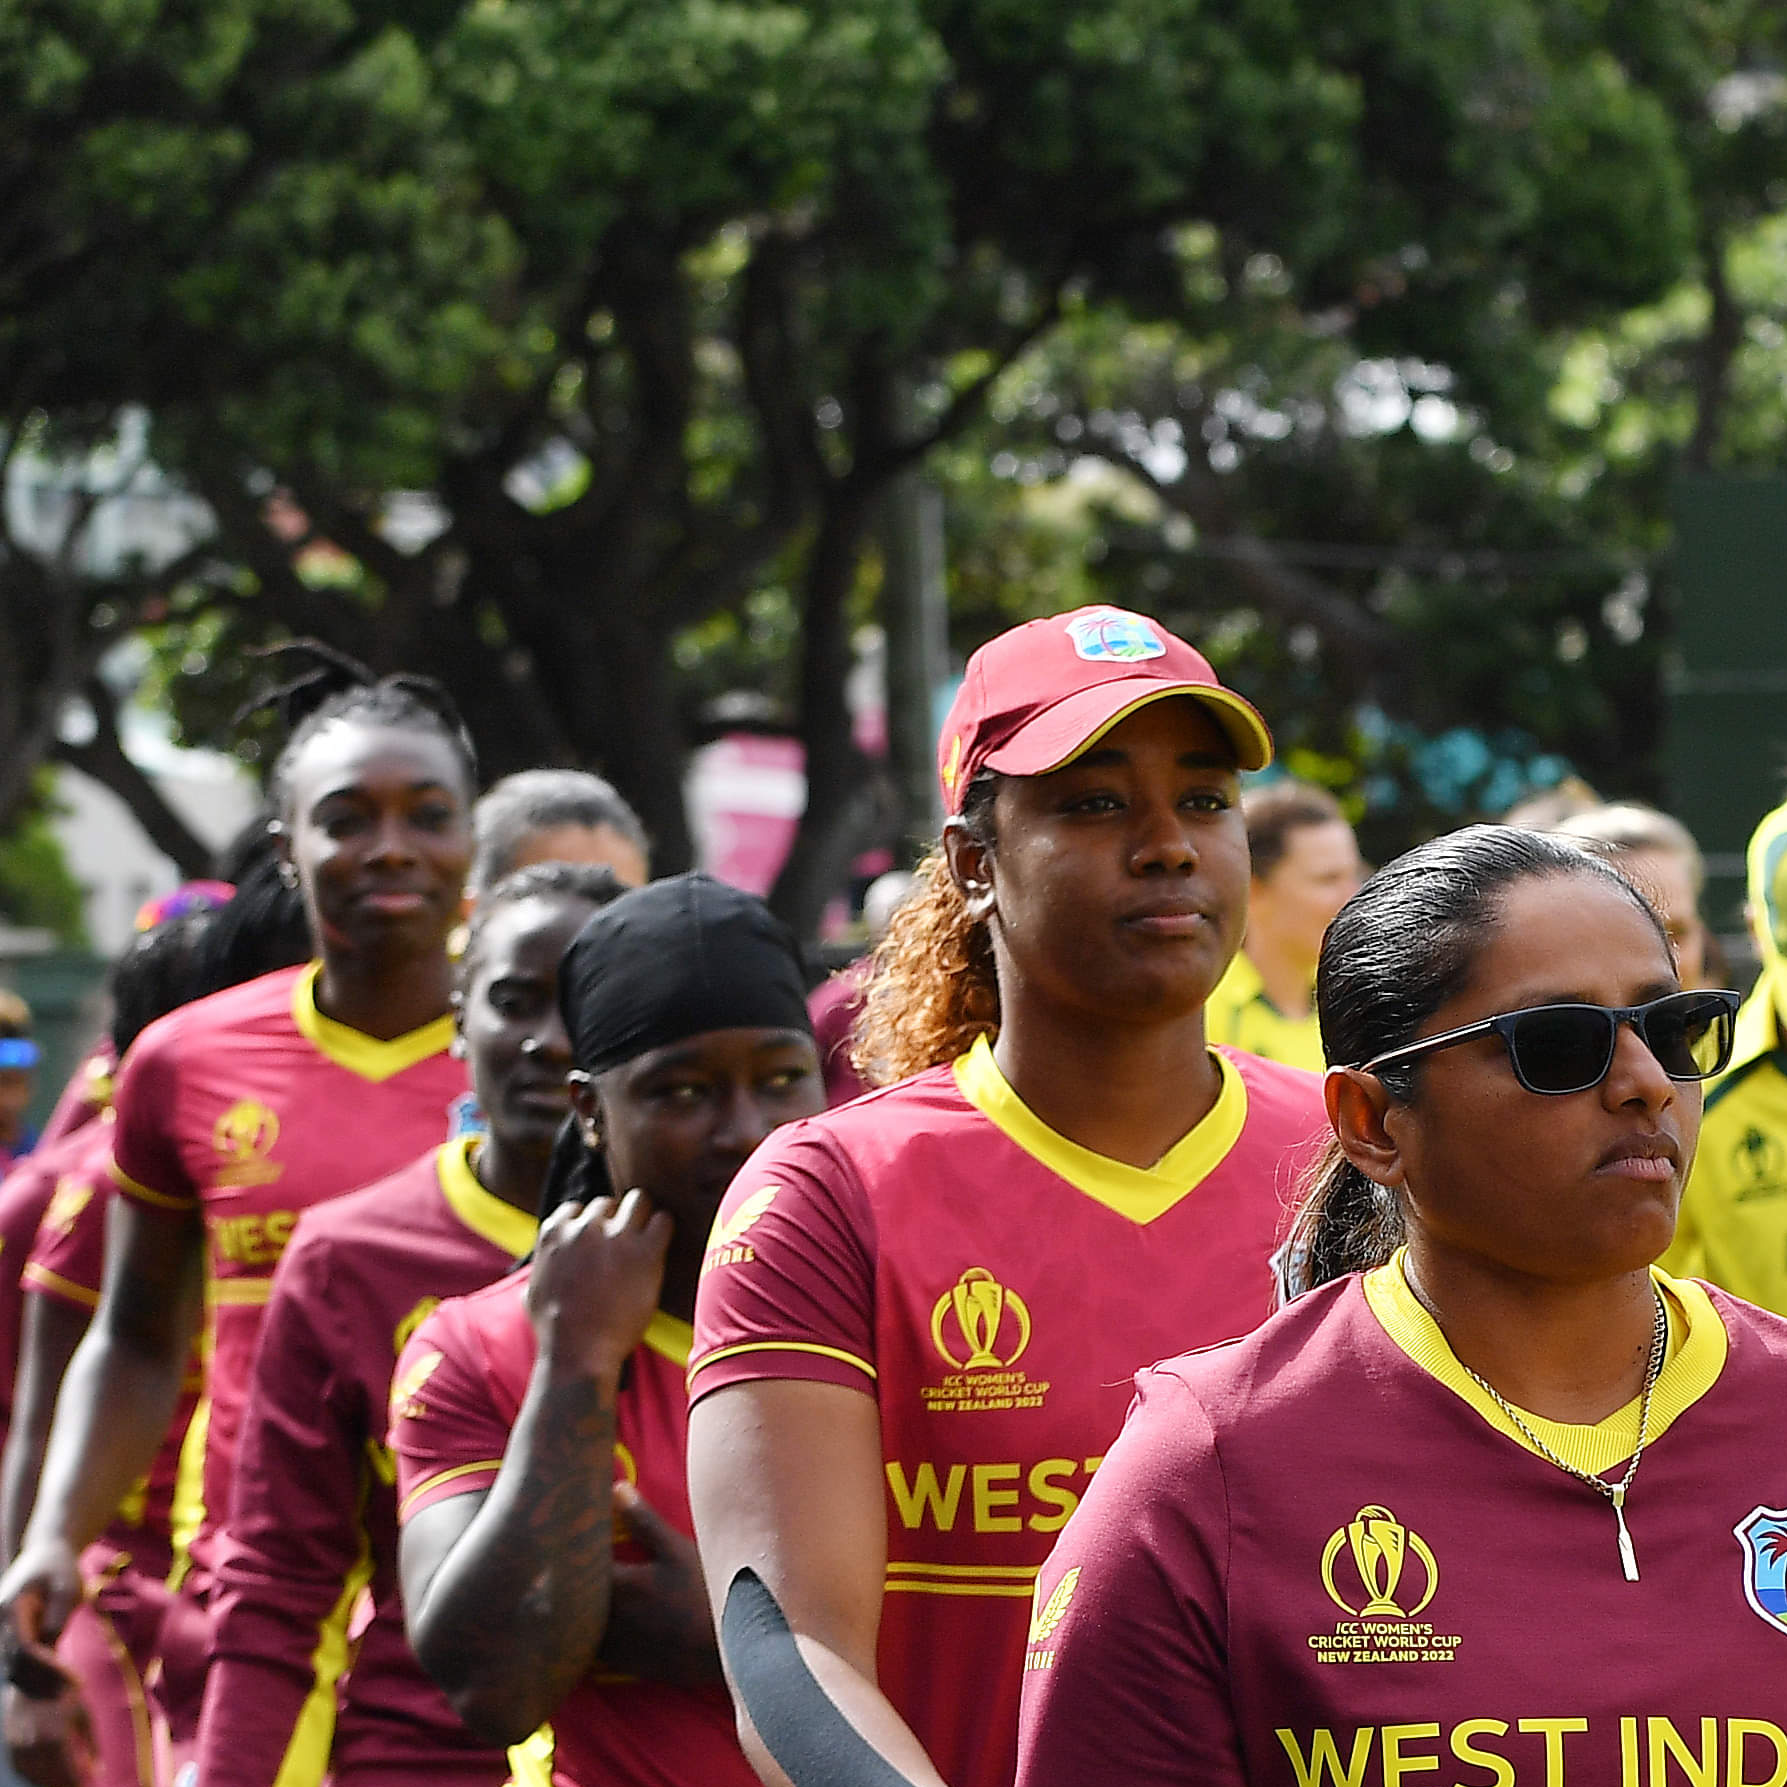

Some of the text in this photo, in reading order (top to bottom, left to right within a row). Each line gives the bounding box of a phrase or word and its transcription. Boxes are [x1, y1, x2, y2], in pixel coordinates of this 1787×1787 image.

[921, 1381, 1051, 1398] CRICKET WORLD CUP
[885, 1456, 1104, 1533] WES
[1336, 1622, 1433, 1635] ICC WOMEN'S
[1308, 1635, 1463, 1649] CRICKET WORLD CUP
[1317, 1650, 1455, 1663] NEW ZEALAND 2022
